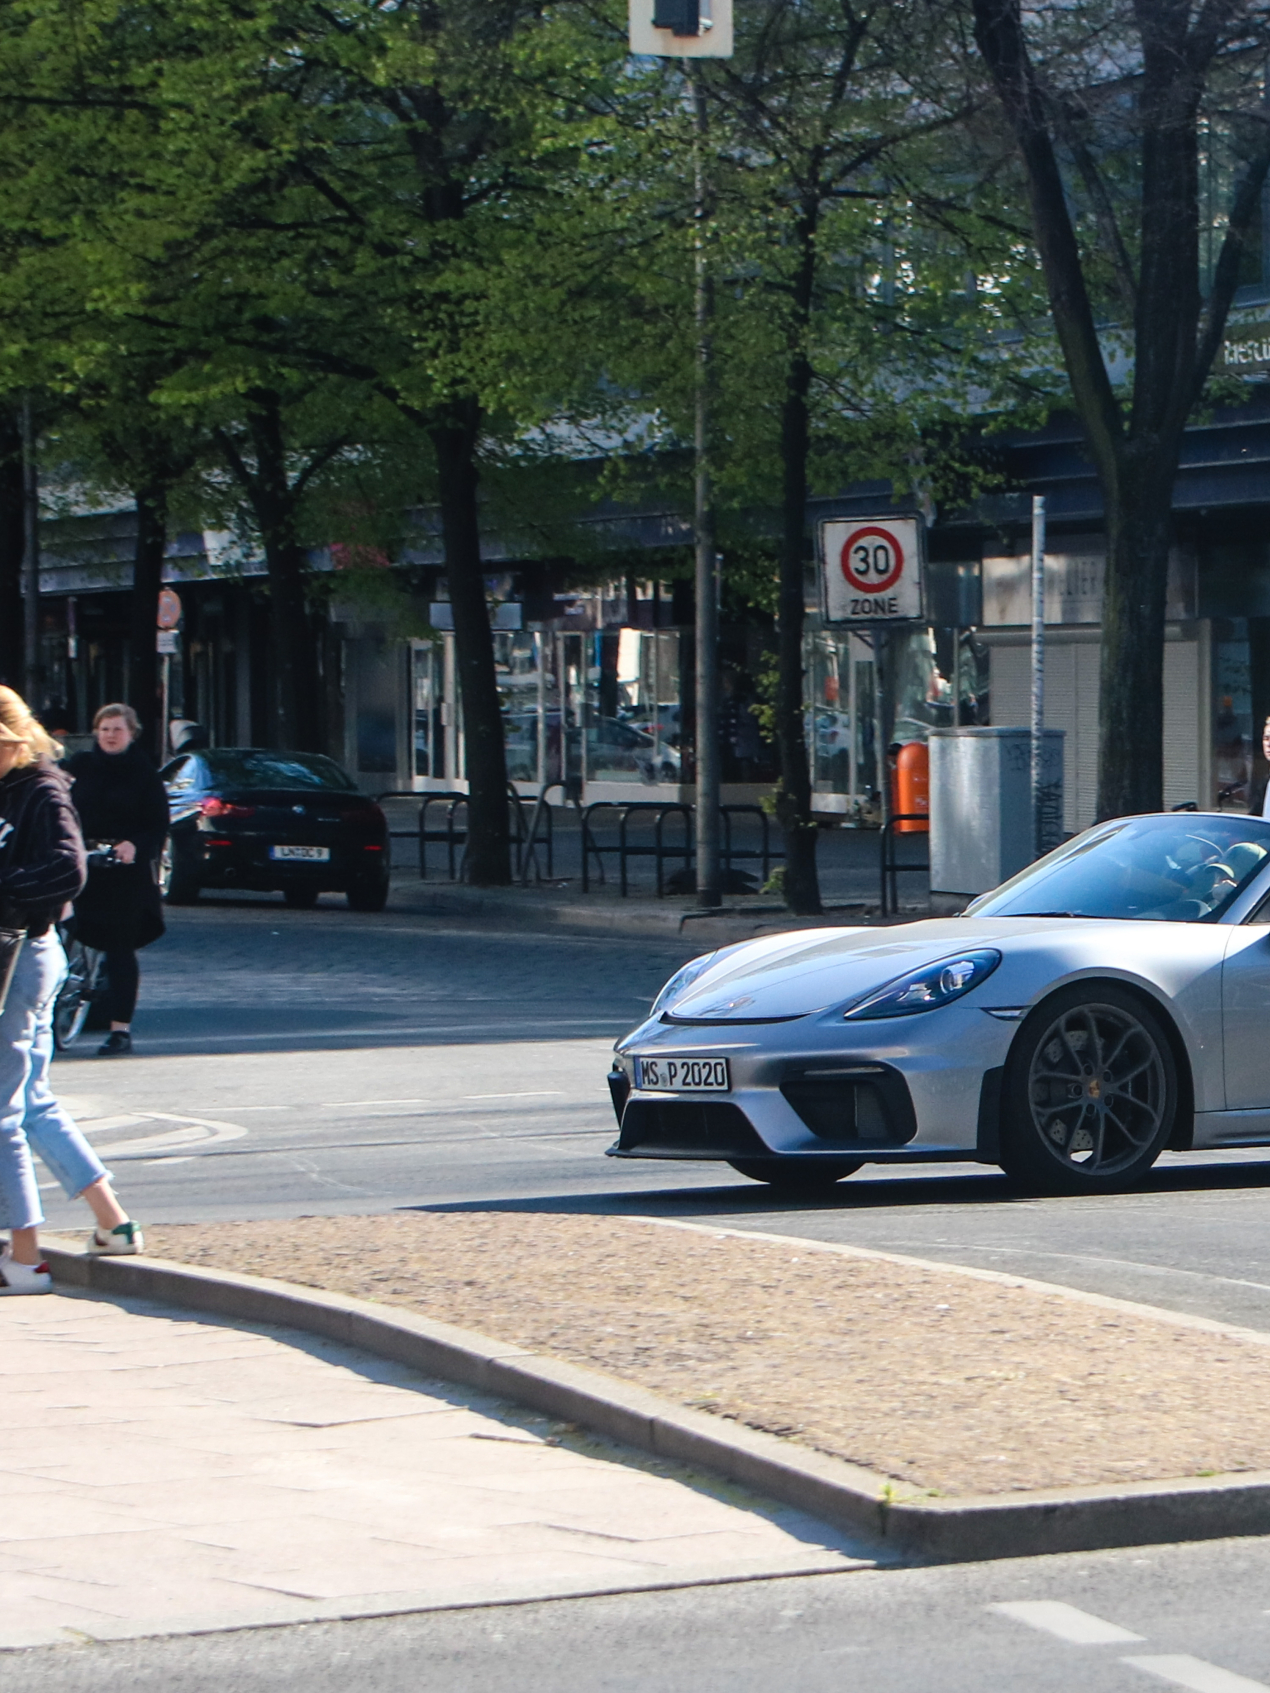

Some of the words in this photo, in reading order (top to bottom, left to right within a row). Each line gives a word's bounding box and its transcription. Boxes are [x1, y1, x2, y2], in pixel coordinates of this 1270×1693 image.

[853, 544, 890, 575] 30
[850, 598, 899, 615] ZONE
[641, 1060, 659, 1086] MS
[667, 1061, 678, 1086] P
[681, 1061, 726, 1087] 2020
